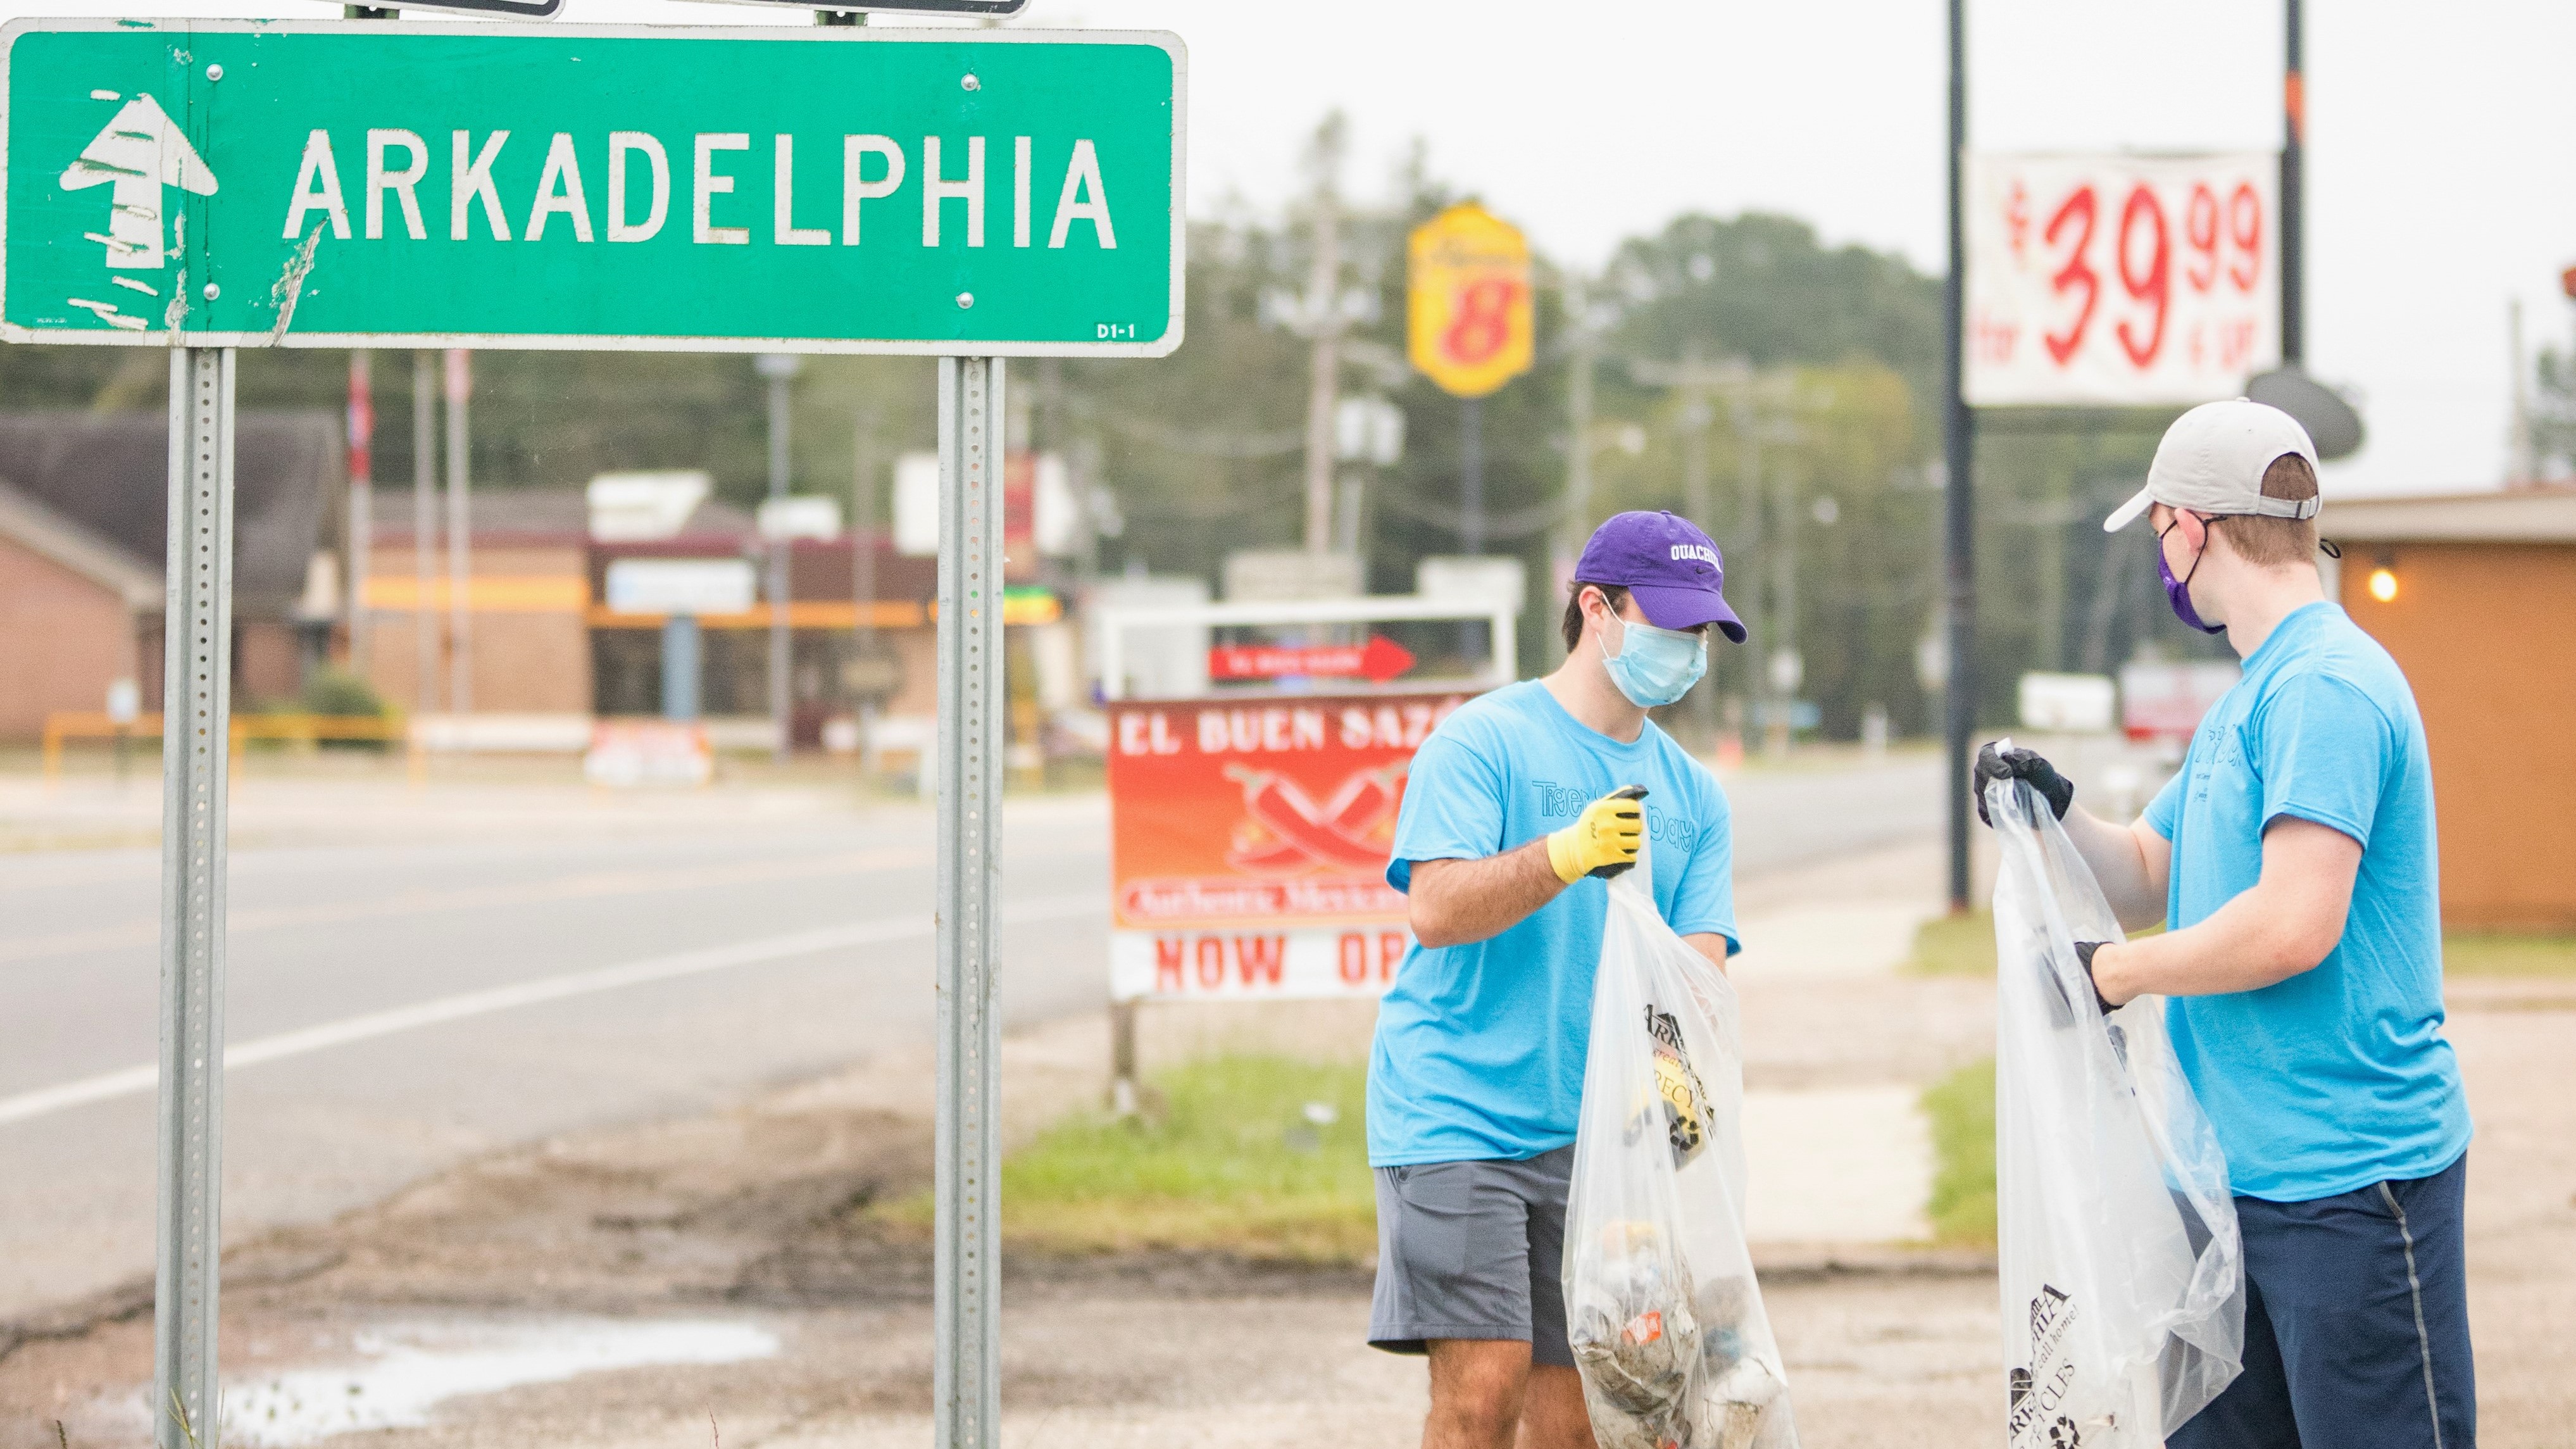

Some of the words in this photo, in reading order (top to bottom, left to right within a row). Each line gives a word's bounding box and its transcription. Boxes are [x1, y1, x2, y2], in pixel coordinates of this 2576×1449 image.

[282, 129, 1117, 249] ARKADELPHIA
[1097, 323, 1134, 339] D1-1
[1120, 711, 1181, 756] EL
[1199, 707, 1325, 753] BUEN
[1532, 780, 1591, 818] Tiger
[1648, 805, 1694, 853] Day
[1157, 933, 1286, 993] NOW
